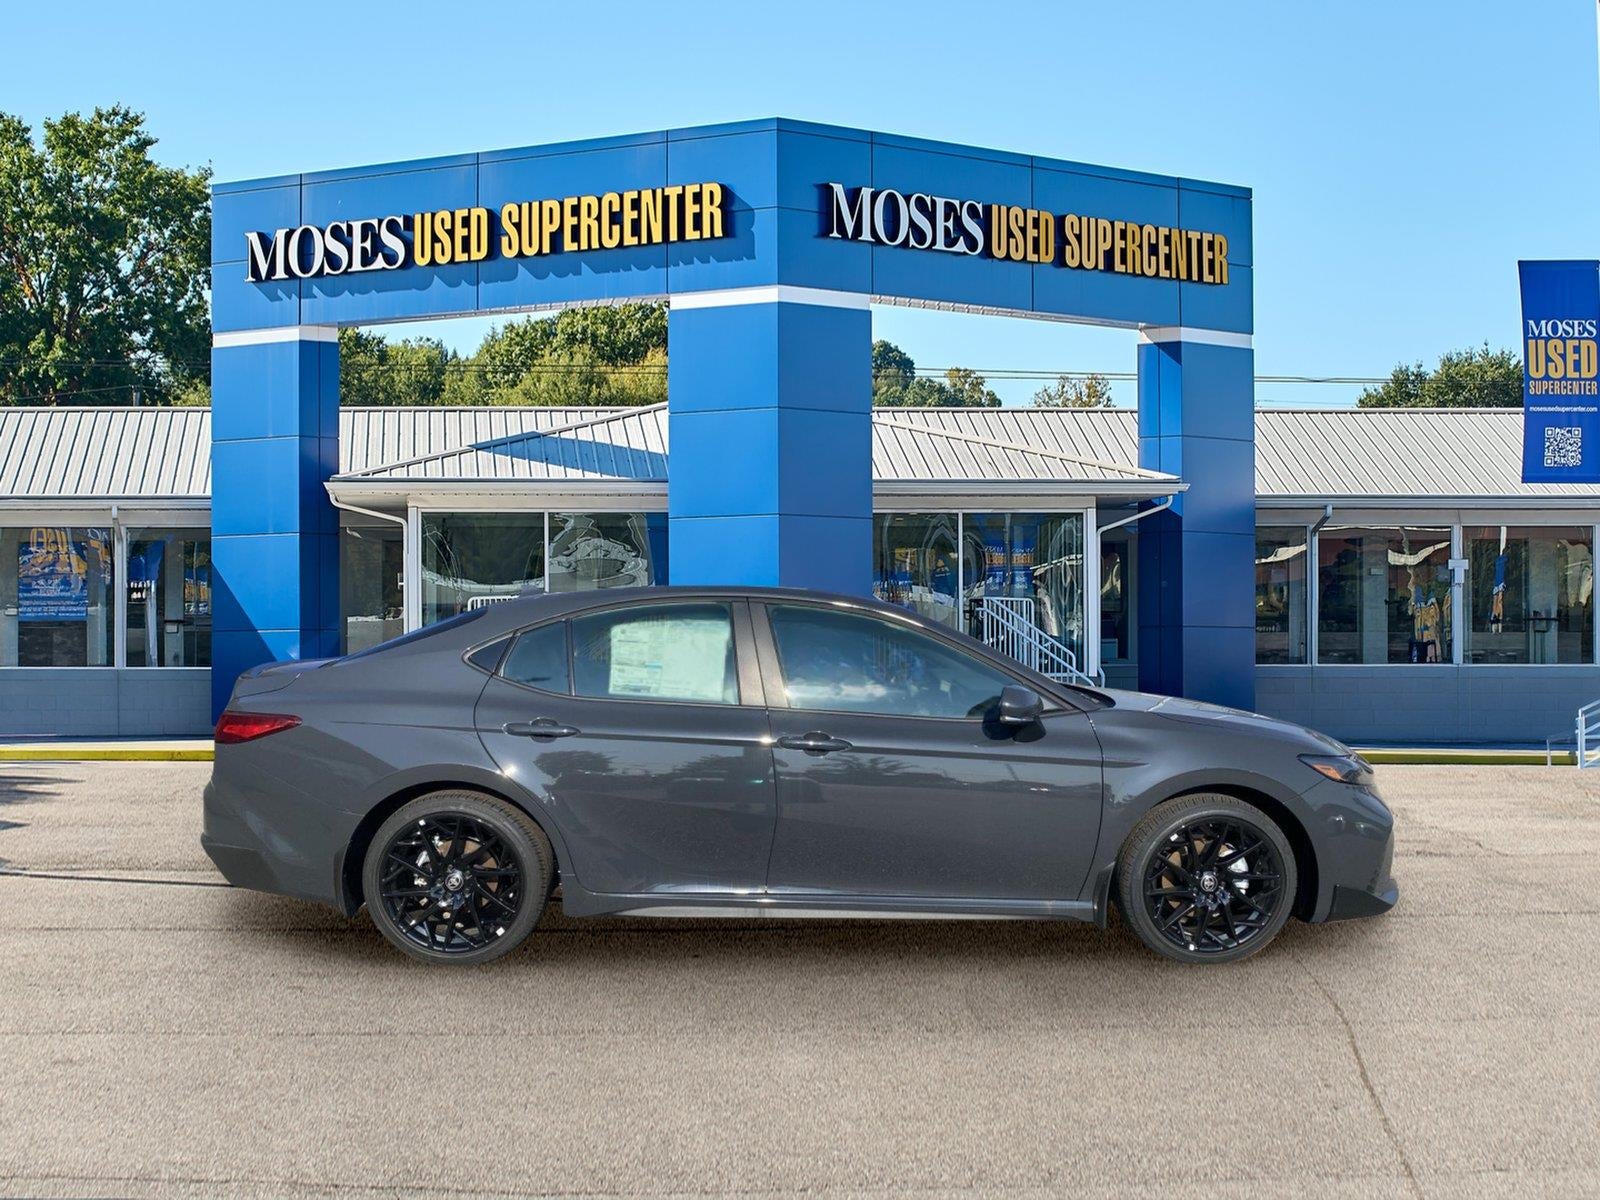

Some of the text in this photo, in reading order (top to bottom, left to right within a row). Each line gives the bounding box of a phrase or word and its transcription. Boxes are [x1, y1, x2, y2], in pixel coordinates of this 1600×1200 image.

[244, 182, 724, 283] MOSES USED SUPERCENTER
[828, 182, 1229, 285] MOSES USED SUPERCENTER
[1527, 319, 1597, 338] MOSES
[1528, 339, 1598, 379] USED
[1529, 381, 1597, 395] SUPERCENTER
